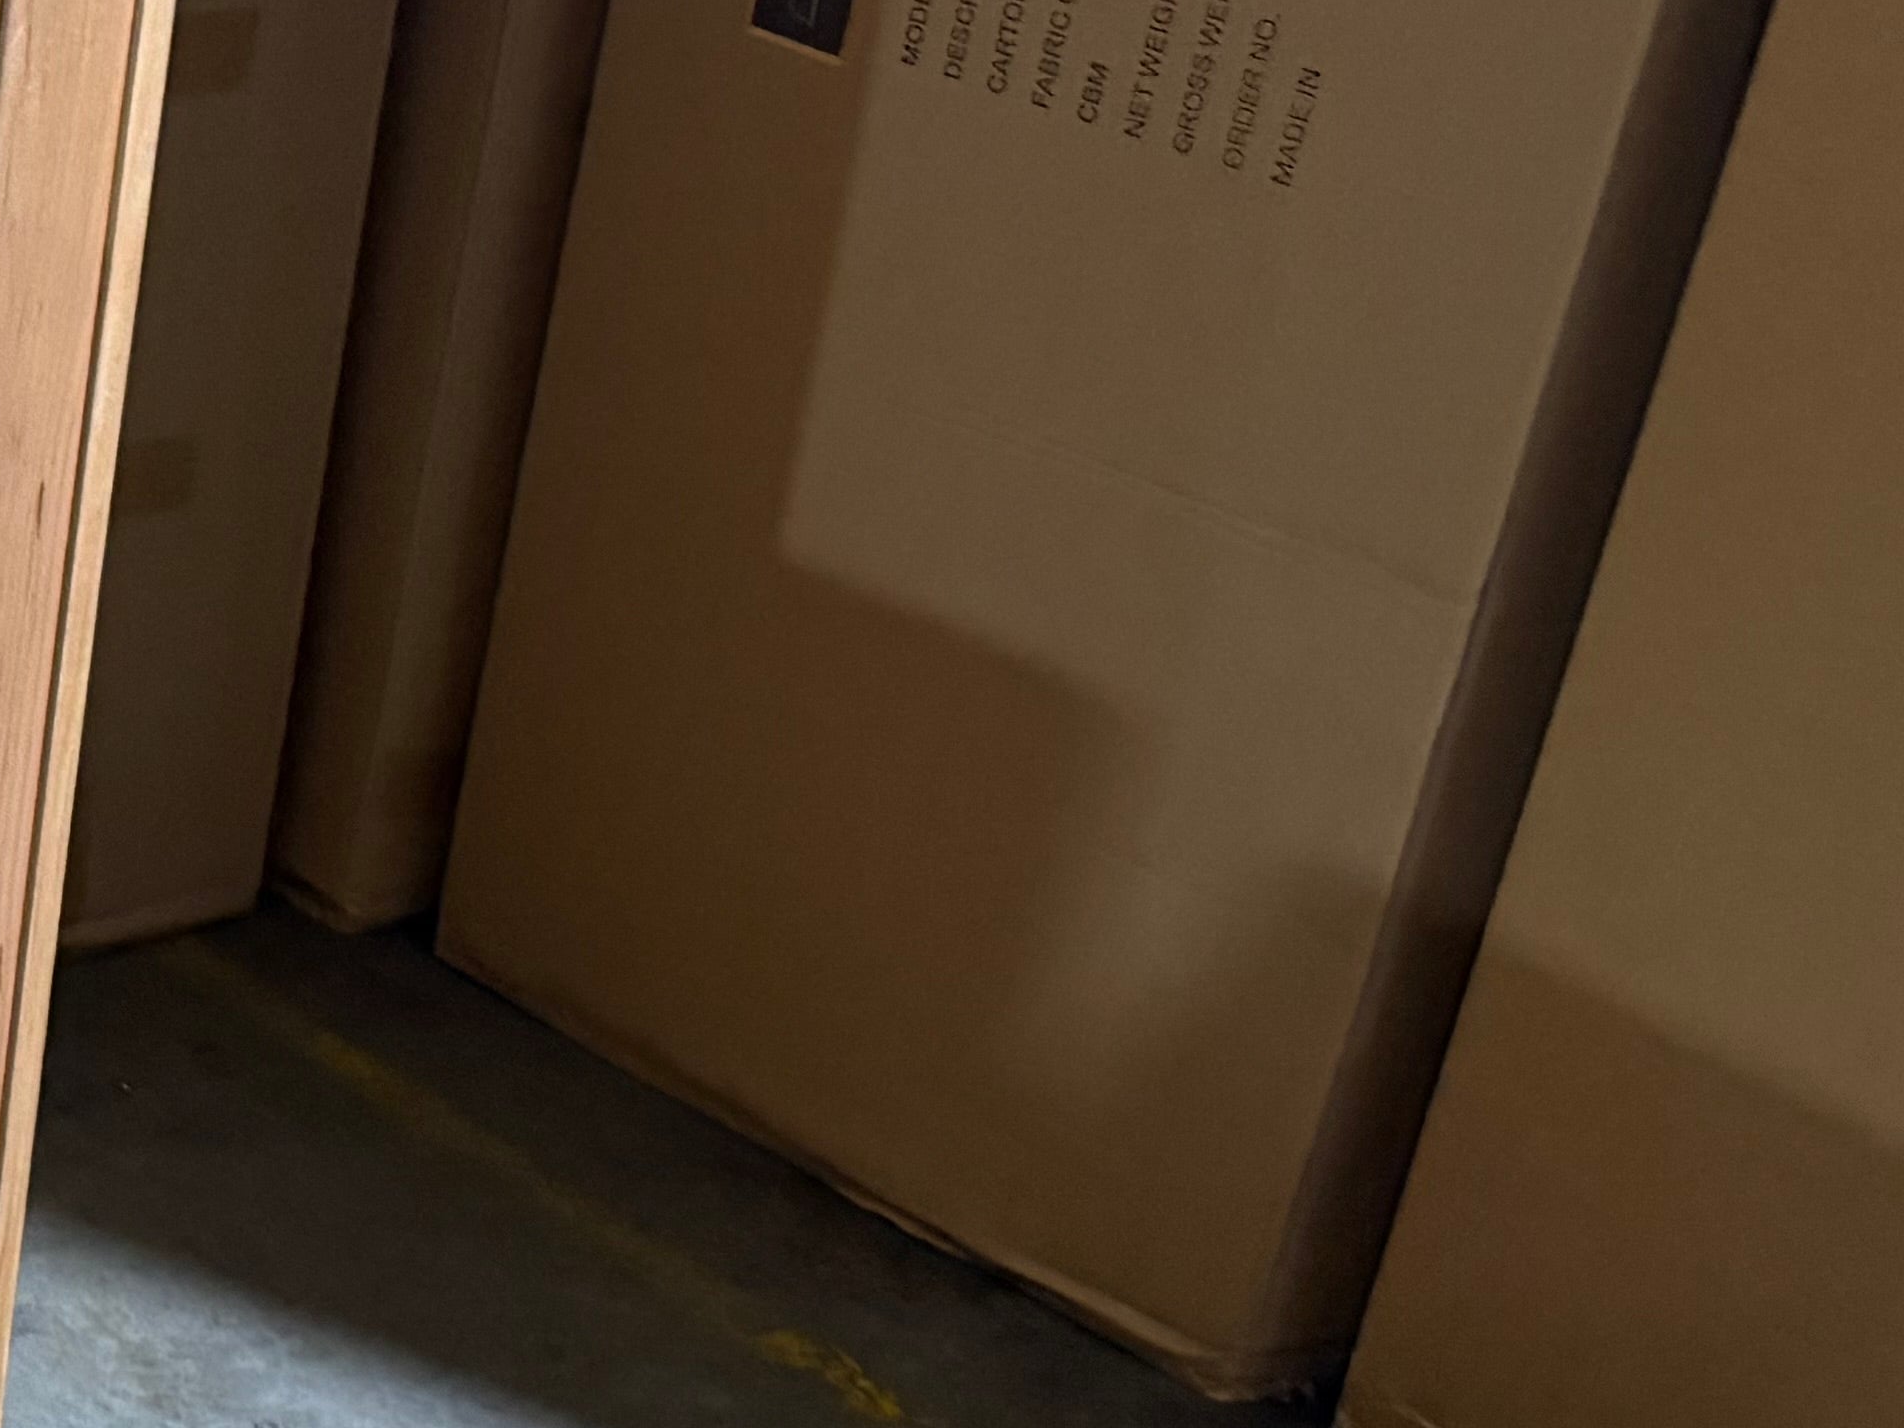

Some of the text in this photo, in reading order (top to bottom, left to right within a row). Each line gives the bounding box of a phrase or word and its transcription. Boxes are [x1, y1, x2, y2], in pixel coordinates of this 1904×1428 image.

[1030, 10, 1072, 110] FABRIC
[1123, 82, 1154, 140] NET
[1172, 54, 1216, 156] GROSS
[1222, 68, 1264, 171] ORDER
[1269, 67, 1322, 187] MADE IN
